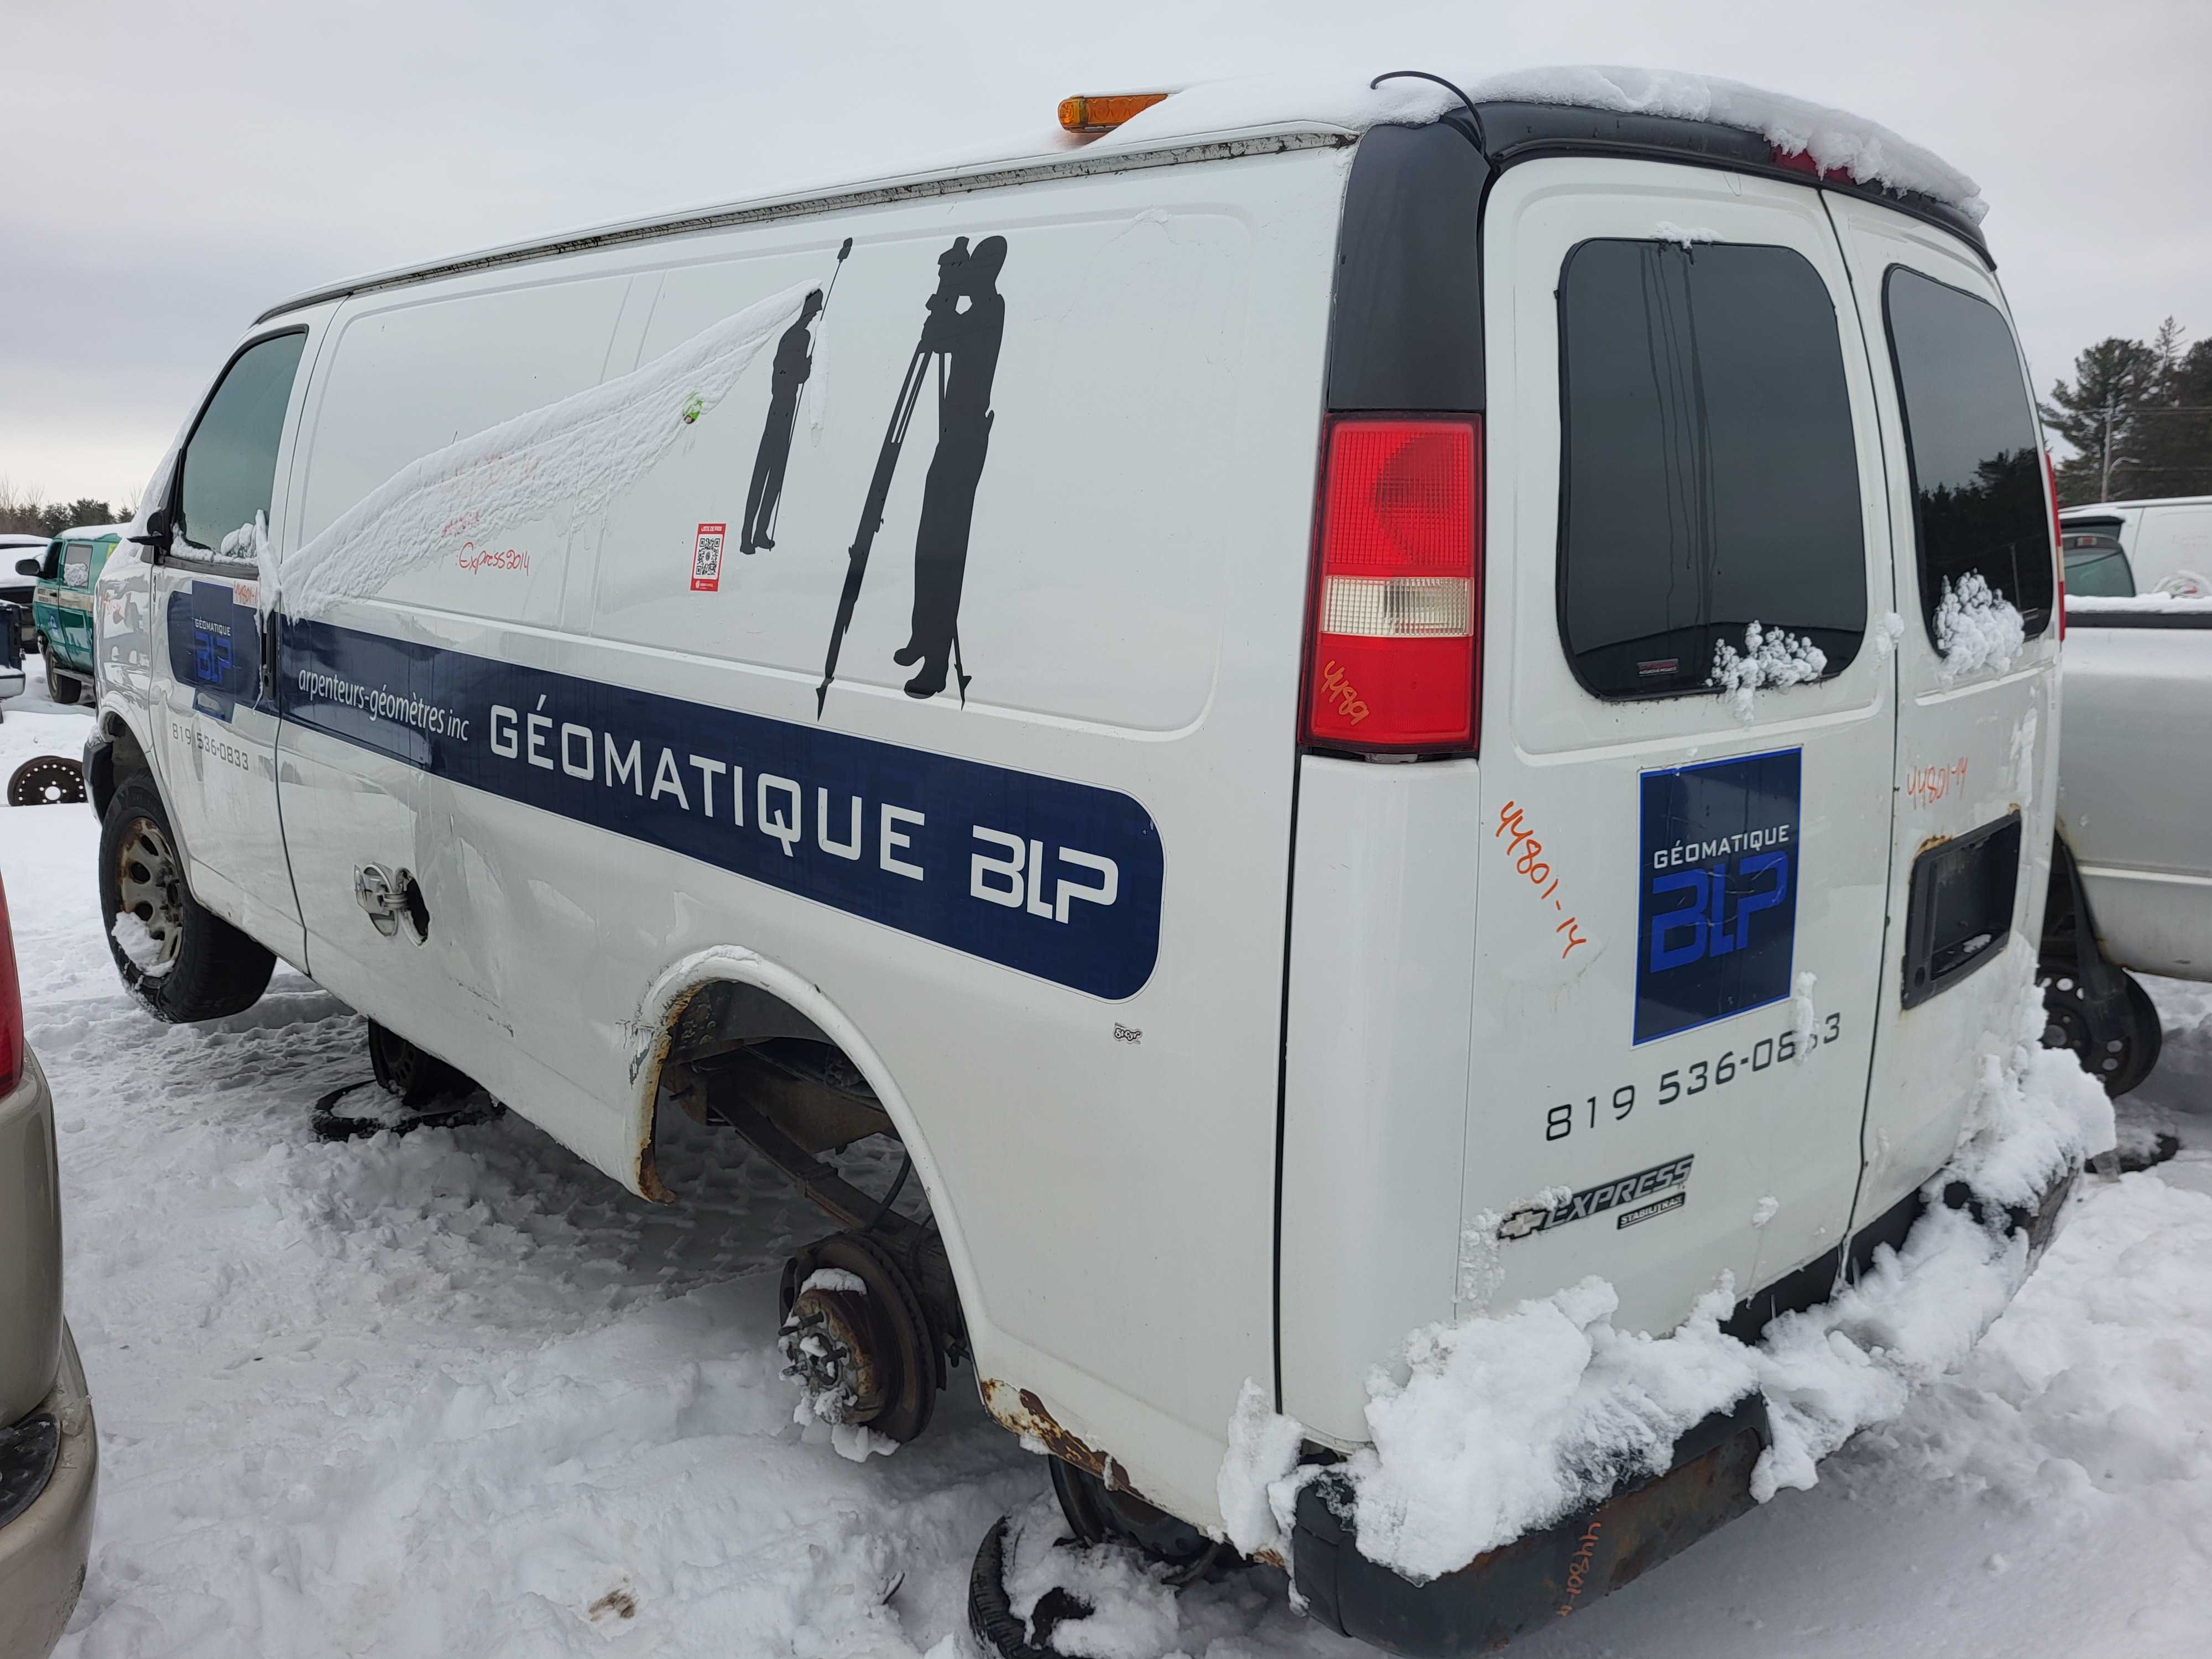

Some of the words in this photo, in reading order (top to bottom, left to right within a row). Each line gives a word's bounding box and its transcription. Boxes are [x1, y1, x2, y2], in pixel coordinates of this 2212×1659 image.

[195, 615, 231, 637] GÉOMATIQUE
[194, 632, 234, 686] BLP
[298, 669, 445, 734] arpenteurs-géomètres
[447, 708, 470, 742] inc
[172, 722, 192, 745] 819
[196, 731, 249, 771] 536-0833
[490, 694, 926, 881] GÉOMATIQUE
[970, 824, 1119, 925] BLP
[1495, 800, 1587, 959] 44801-14
[1653, 824, 1791, 870] GÉOMATIQUE
[1650, 851, 1790, 974] BLP
[1546, 1084, 1635, 1141] 819
[1544, 1156, 1694, 1230] EXPRESS
